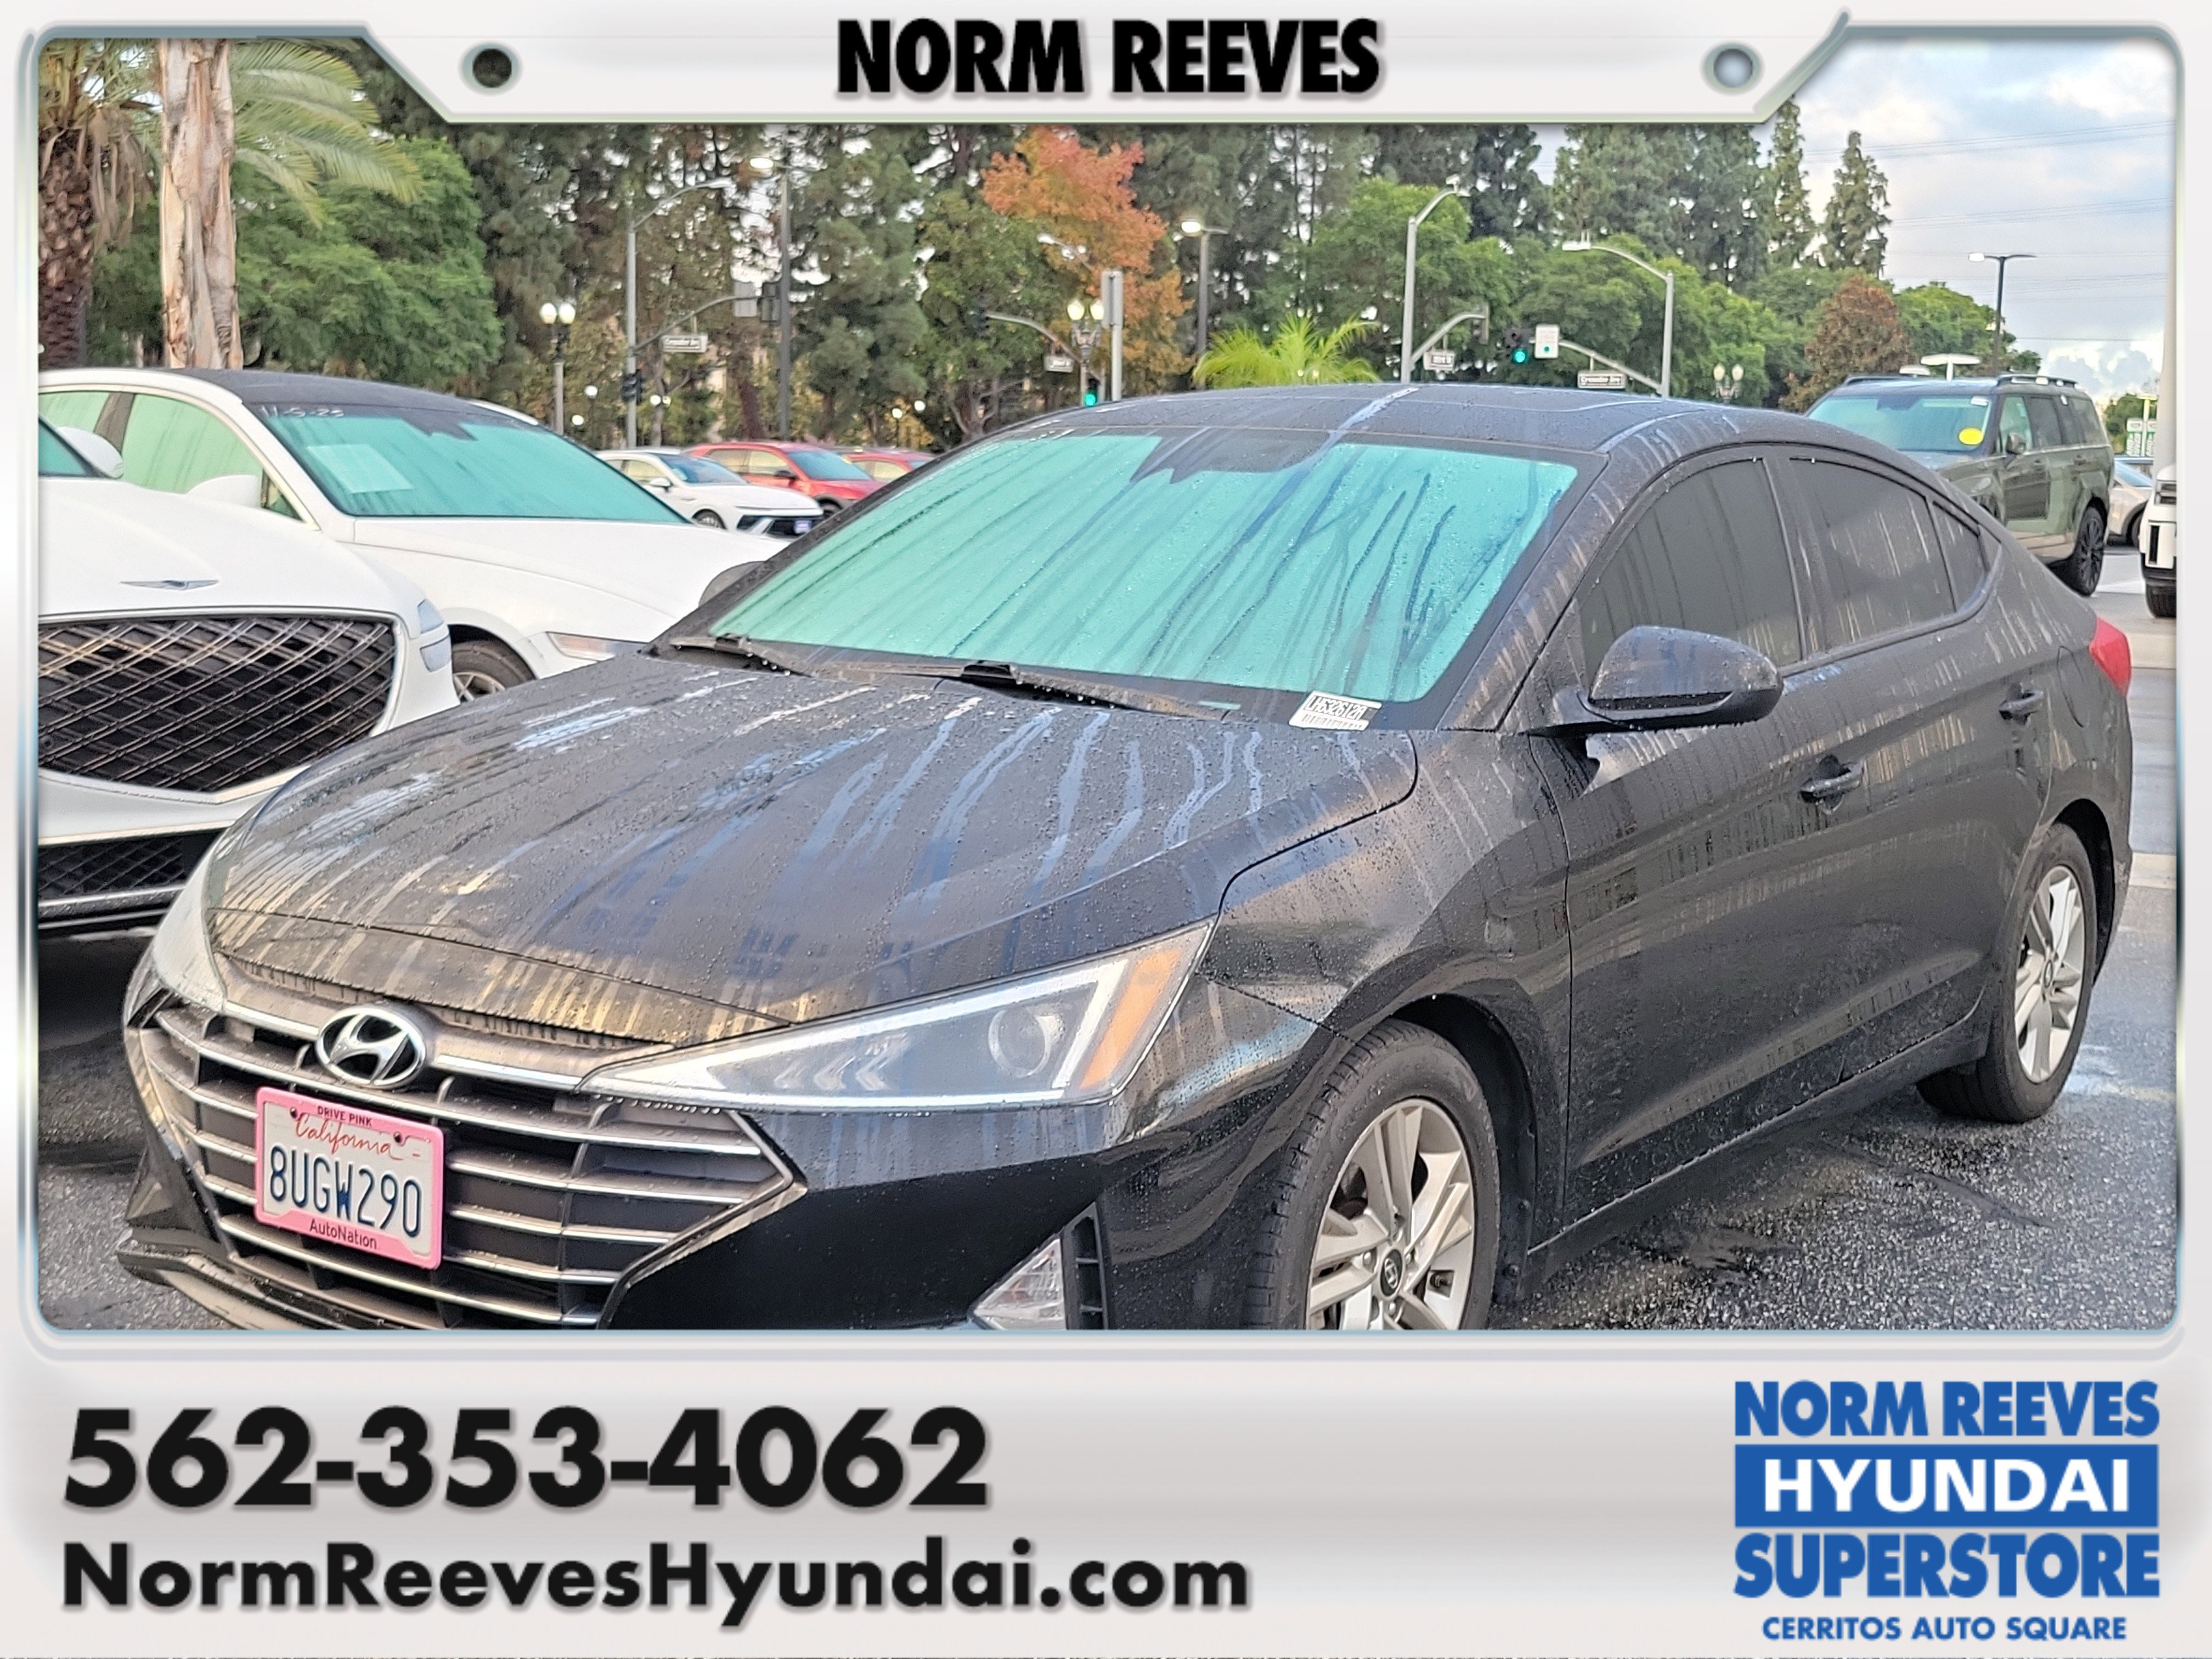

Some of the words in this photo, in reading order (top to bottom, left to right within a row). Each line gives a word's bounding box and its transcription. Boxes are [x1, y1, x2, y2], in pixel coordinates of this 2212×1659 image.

[317, 1105, 346, 1121] DRIVE
[349, 1113, 373, 1127] PINK
[296, 1112, 403, 1160] California
[269, 1146, 423, 1238] 8UGW290
[309, 1219, 377, 1250] AutoNation
